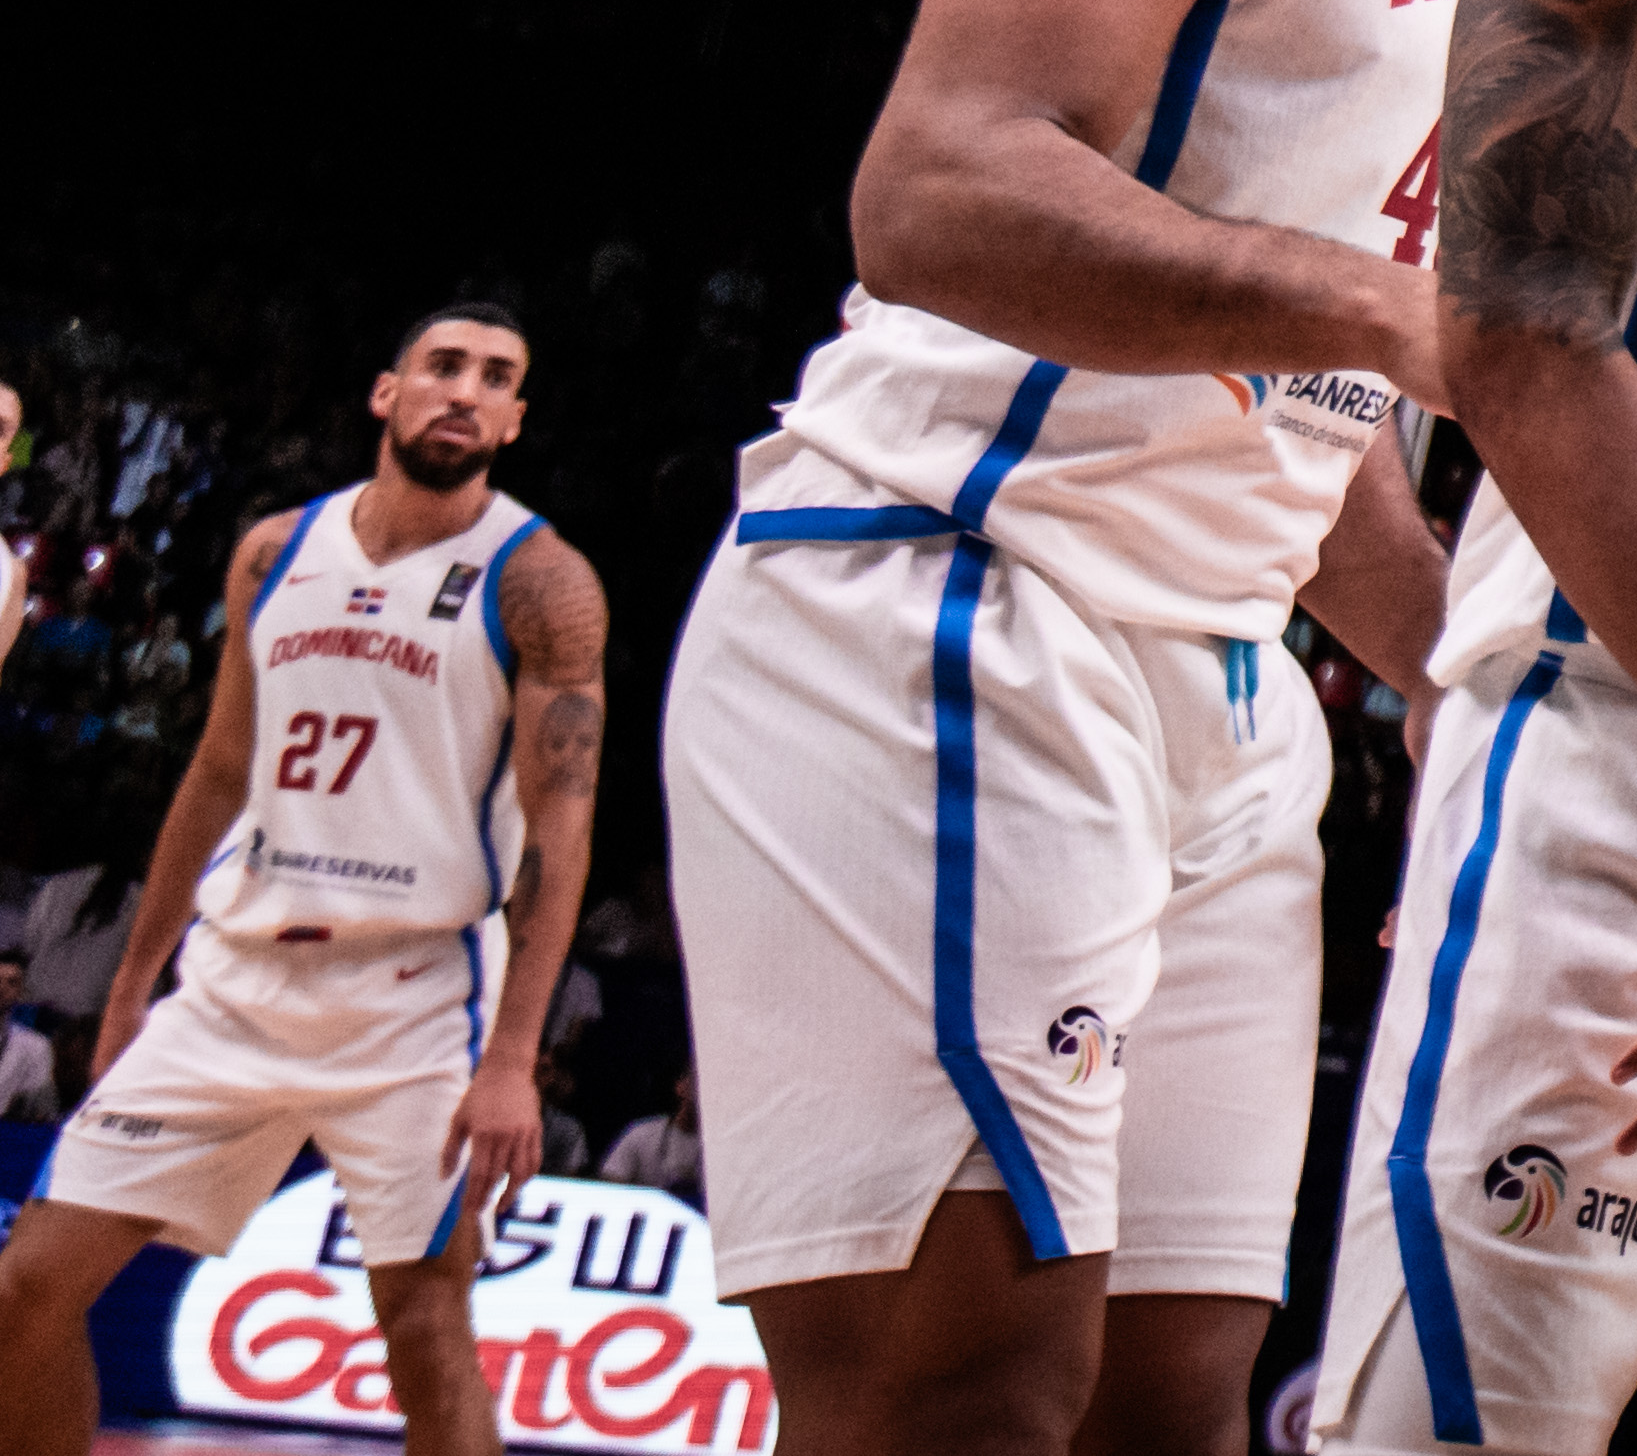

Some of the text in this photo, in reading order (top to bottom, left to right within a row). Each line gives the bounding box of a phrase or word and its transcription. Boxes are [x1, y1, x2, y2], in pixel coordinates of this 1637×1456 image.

[1379, 111, 1443, 268] 4
[268, 625, 440, 687] DOMINICANA
[276, 709, 379, 796] 27
